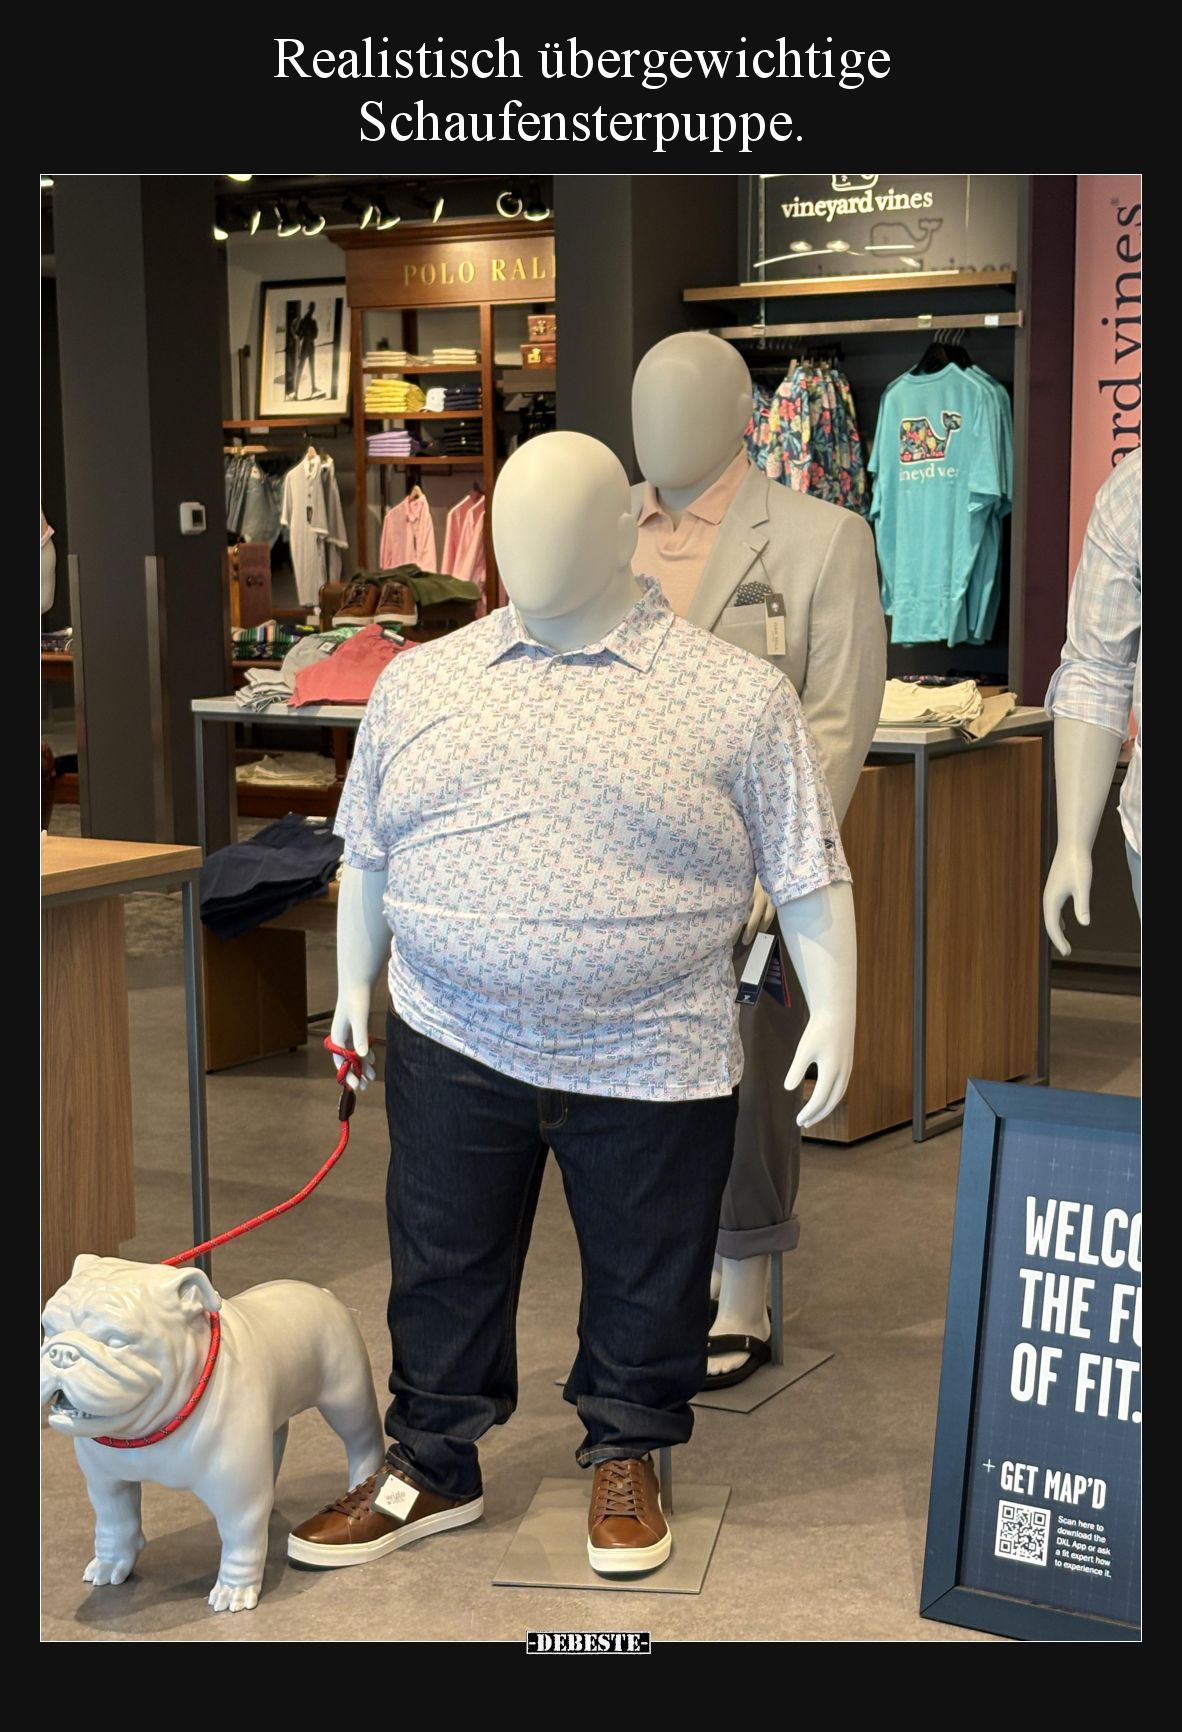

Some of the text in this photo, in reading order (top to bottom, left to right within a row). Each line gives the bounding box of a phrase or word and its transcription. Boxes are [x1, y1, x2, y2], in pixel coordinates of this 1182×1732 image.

[781, 188, 933, 223] vineyard vines
[404, 255, 556, 287] POLO RAL
[1019, 1268, 1096, 1339] THE
[1010, 1342, 1141, 1424] OF FIT.
[1000, 1460, 1107, 1510] GET MAP'D
[1057, 1515, 1104, 1532] Scan here to
[1057, 1527, 1106, 1543] download the
[1056, 1537, 1071, 1547] DXL
[1072, 1540, 1087, 1551] App
[1097, 1546, 1111, 1555] ask
[1055, 1559, 1112, 1578] to experience it.
[1071, 1552, 1094, 1563] expert
[1095, 1556, 1111, 1566] how
